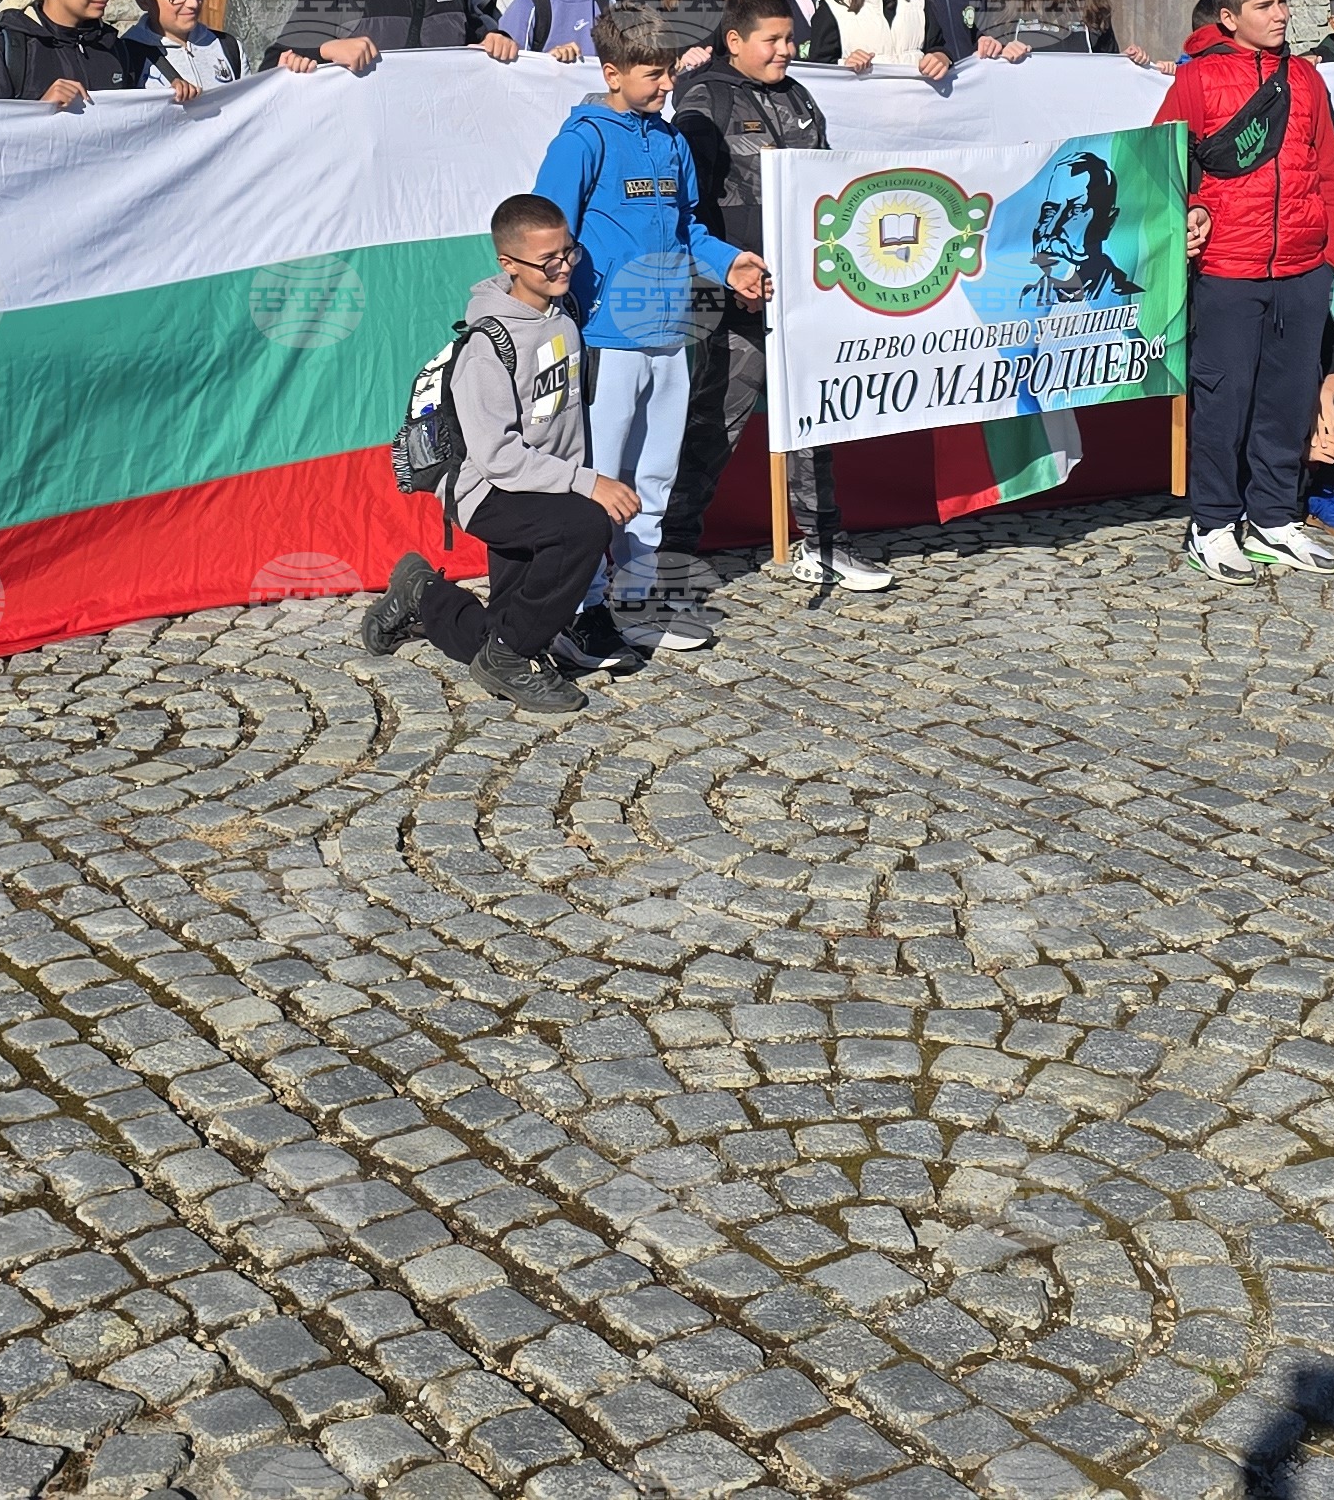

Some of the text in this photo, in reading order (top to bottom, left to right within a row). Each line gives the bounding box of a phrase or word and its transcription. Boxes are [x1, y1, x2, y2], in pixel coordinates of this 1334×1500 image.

[1235, 117, 1265, 154] NIKE
[836, 242, 960, 303] КОЧО МАВРОДИЕВ
[834, 306, 1138, 364] ПЪРВО ОСНОВНО УЧИЛИЩЕ
[798, 335, 1167, 438] „КОЧО МАВРОДИЕВ“
